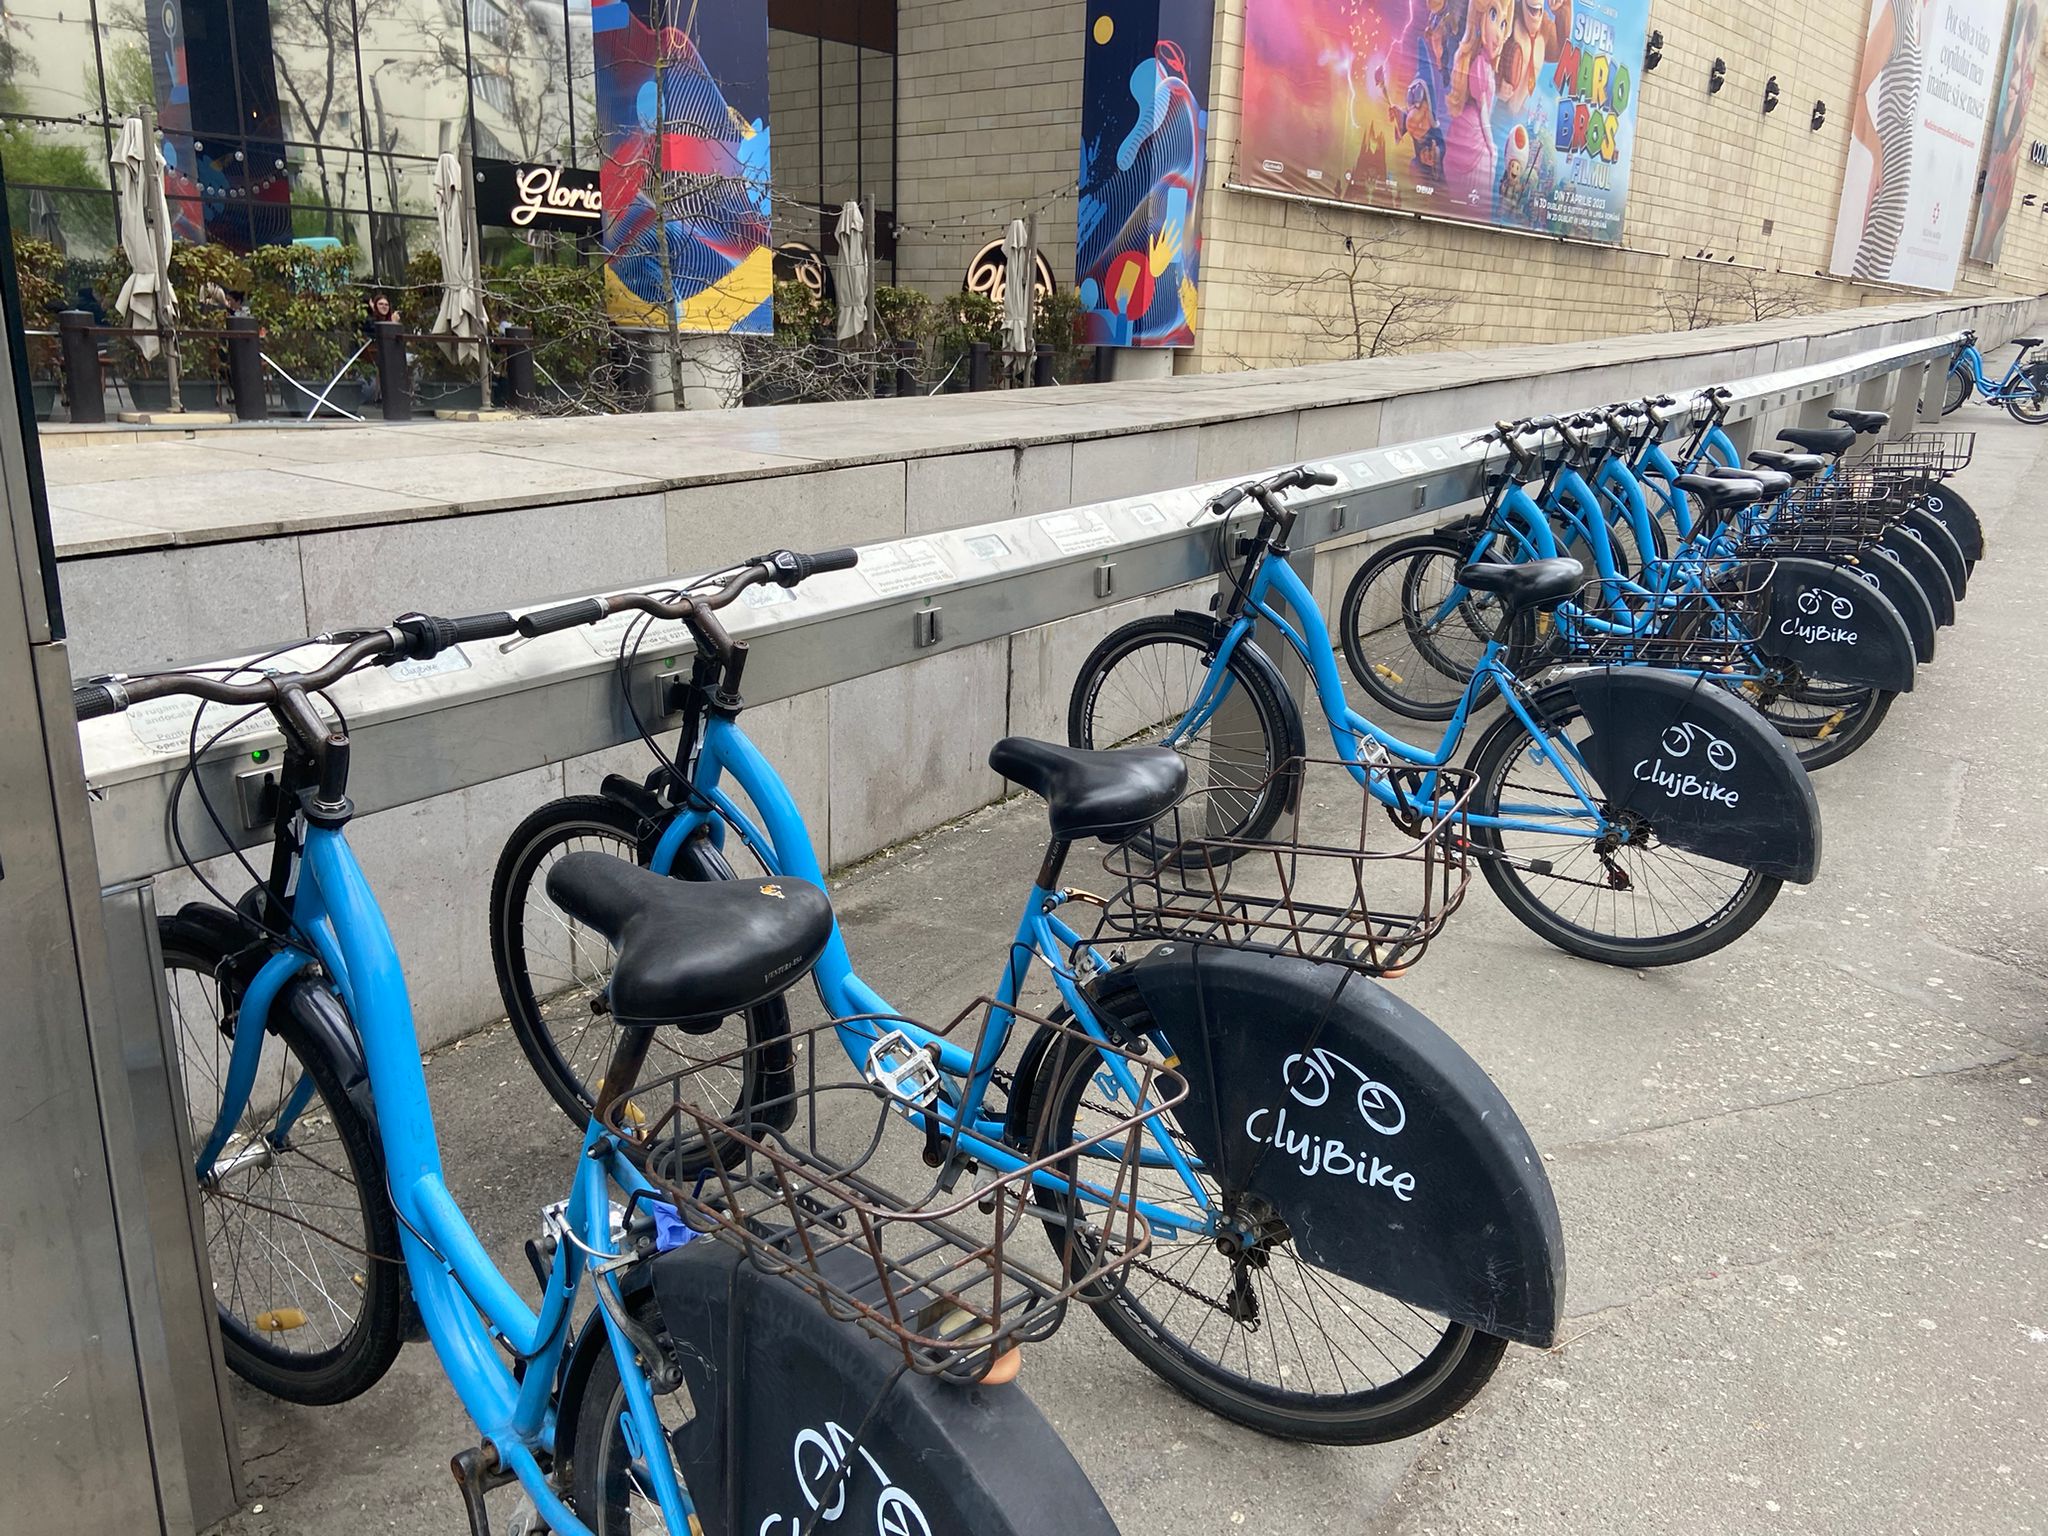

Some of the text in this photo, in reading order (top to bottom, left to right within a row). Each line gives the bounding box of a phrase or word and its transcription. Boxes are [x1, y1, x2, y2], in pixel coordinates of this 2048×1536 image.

[1574, 13, 1615, 55] SUPER
[1553, 39, 1630, 117] MARIO
[1570, 157, 1611, 191] FILMUL
[1554, 190, 1565, 202] DIN
[1592, 198, 1606, 209] 2023
[1780, 617, 1858, 645] ClujBike
[1633, 758, 1739, 809] ClujBike
[1245, 1108, 1416, 1202] ClujBike
